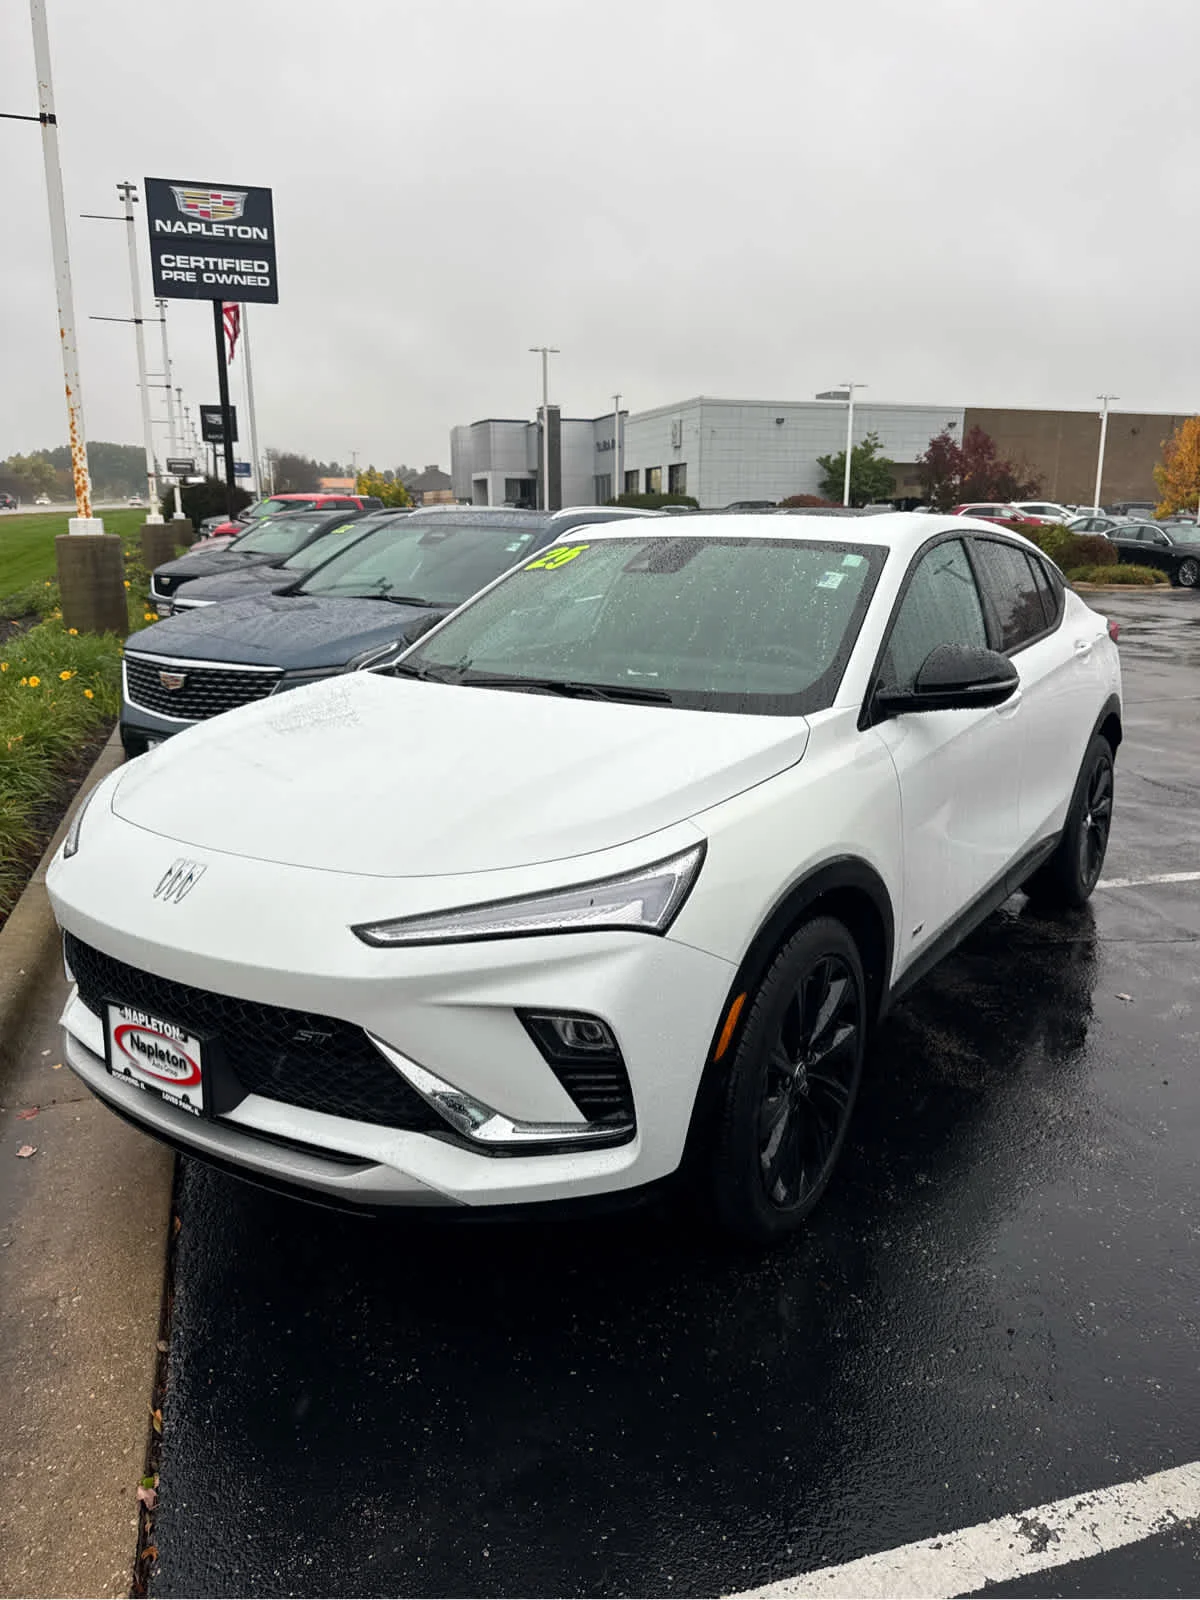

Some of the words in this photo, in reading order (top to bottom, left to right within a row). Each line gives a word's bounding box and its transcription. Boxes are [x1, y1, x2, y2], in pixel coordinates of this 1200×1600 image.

[155, 219, 268, 240] NAPLETON
[160, 254, 269, 273] CERTIFIED
[161, 270, 197, 282] PRE
[203, 273, 270, 287] OWNED
[124, 1006, 181, 1040] NAPLETON
[129, 1031, 188, 1071] Napleton
